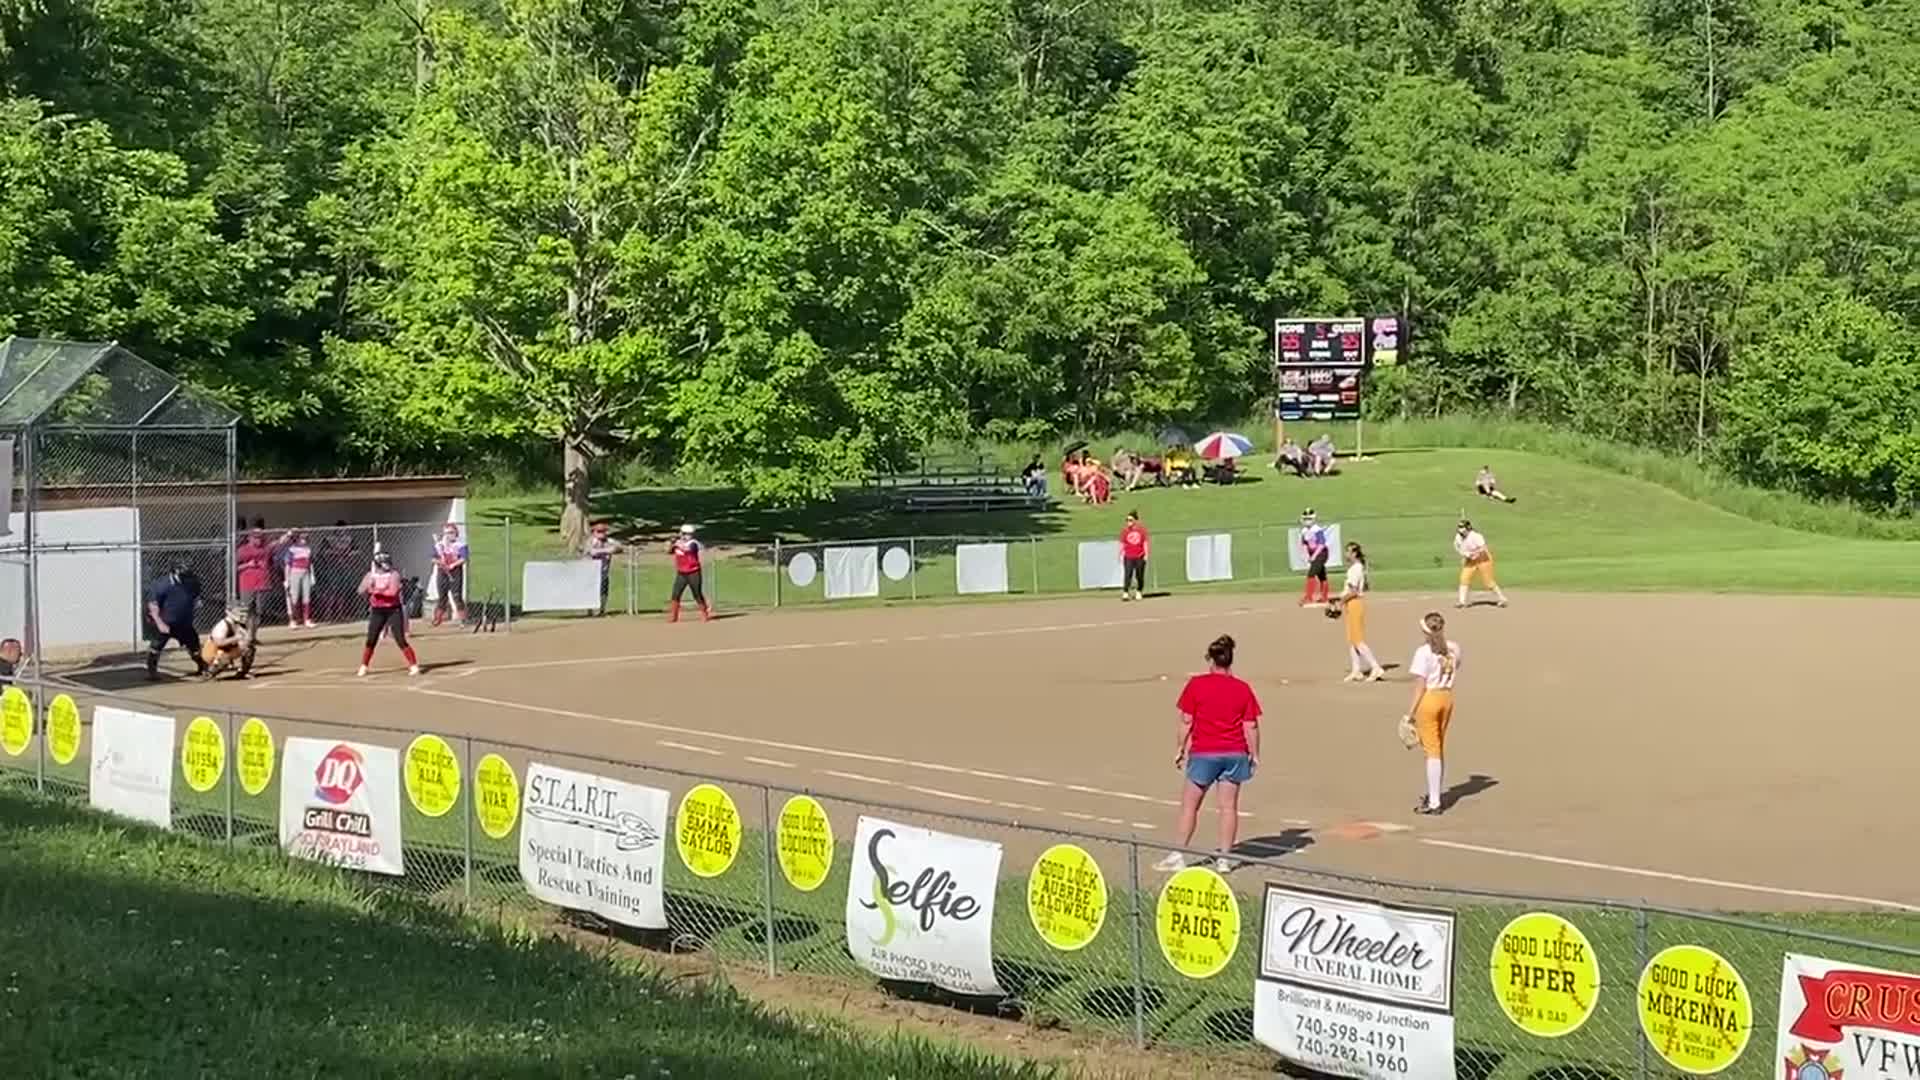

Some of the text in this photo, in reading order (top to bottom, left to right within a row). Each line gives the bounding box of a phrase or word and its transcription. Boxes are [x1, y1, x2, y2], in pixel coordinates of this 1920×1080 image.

[320, 758, 357, 794] DQ
[529, 775, 617, 820] S.T.A.R.T.
[709, 804, 734, 824] LUCK
[306, 810, 368, 834] Grill Chill
[687, 815, 729, 840] EMMA
[802, 815, 826, 833] LUCK
[680, 829, 733, 857] SAYLOR
[528, 838, 653, 885] Special Tactics And
[1039, 858, 1098, 890] GOOD LUCK
[538, 867, 641, 916] Rescue Training
[859, 829, 981, 932] Selfie
[1041, 878, 1091, 905] AUBREE
[1031, 889, 1098, 924] CALDWELL
[1167, 885, 1230, 912] GOOD LUCK
[1171, 911, 1222, 940] PAIGE
[1280, 906, 1433, 971] Wheeler
[1503, 934, 1585, 963] GOOD LUCK
[889, 952, 927, 972] PHOTO
[930, 961, 973, 981] BOOTH
[1294, 953, 1424, 992] FUNERAL HOME
[1510, 963, 1576, 994] PIPER
[1652, 963, 1738, 1002] GOOD LUCK
[1277, 988, 1430, 1032] Brilliant & Mingo Junction
[1647, 989, 1738, 1032] MCKENNA
[1296, 1014, 1406, 1053] 740-598-4191
[1296, 1034, 1408, 1074] 740-282-1960
